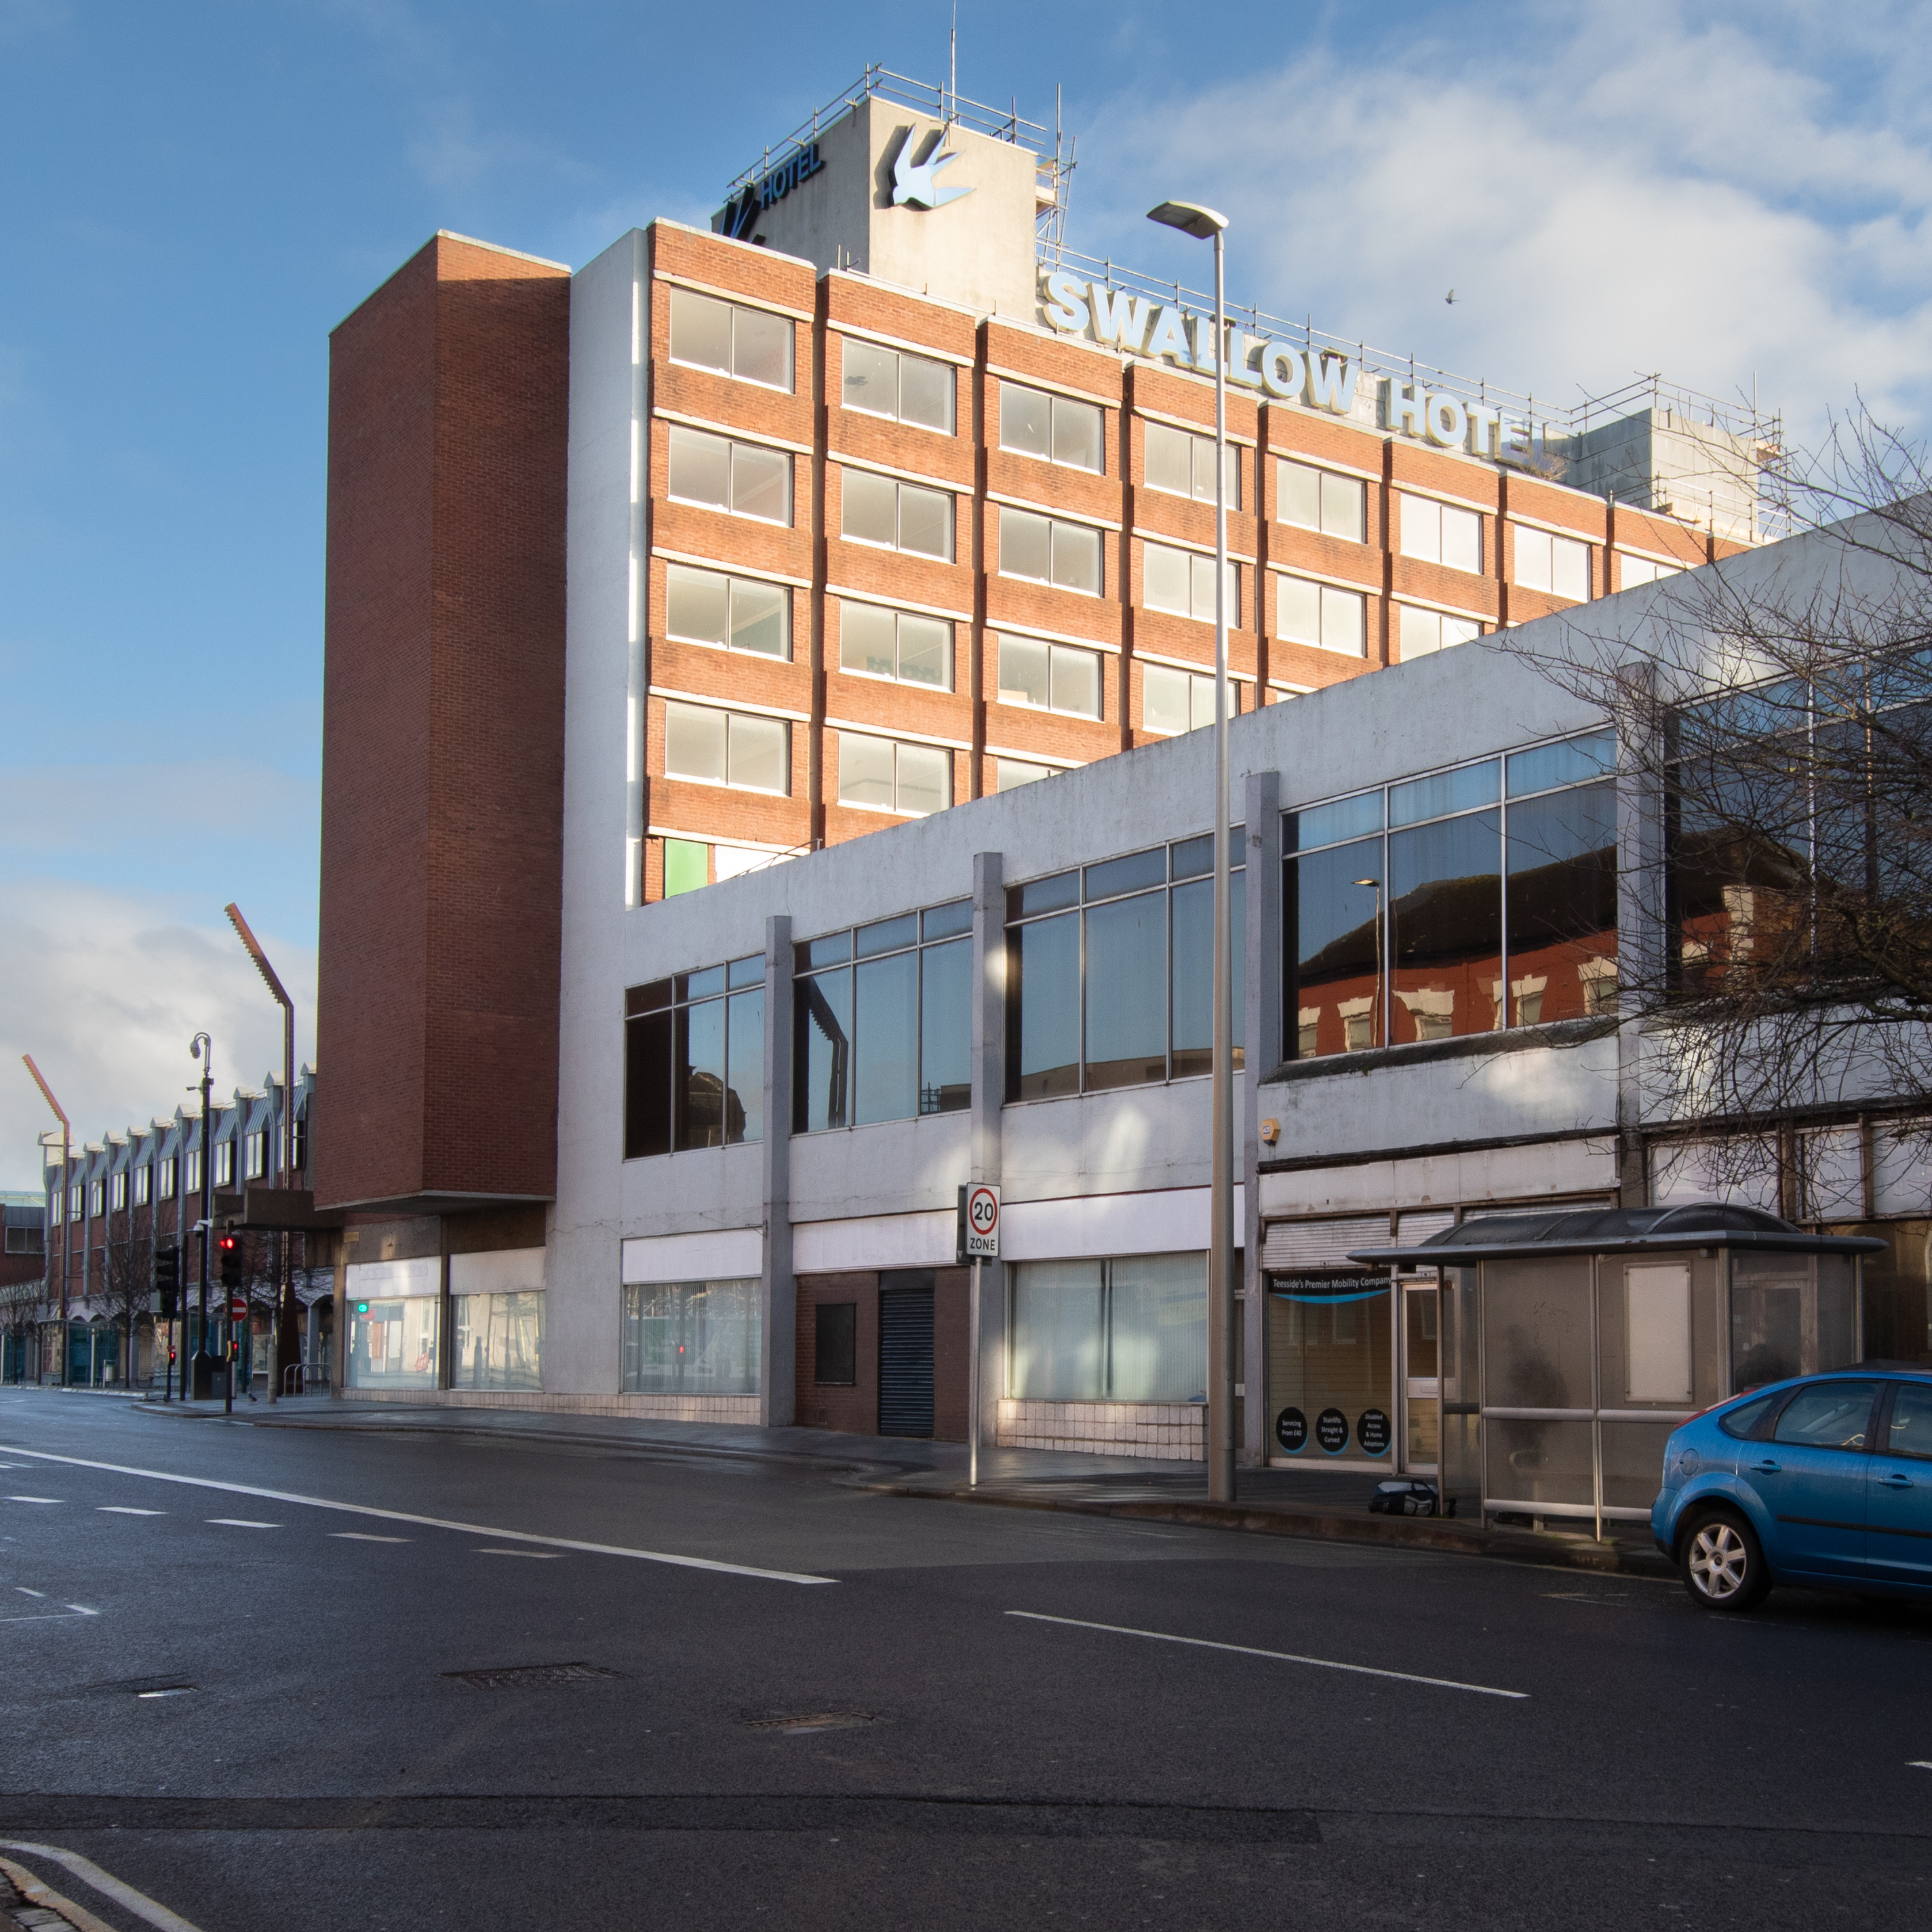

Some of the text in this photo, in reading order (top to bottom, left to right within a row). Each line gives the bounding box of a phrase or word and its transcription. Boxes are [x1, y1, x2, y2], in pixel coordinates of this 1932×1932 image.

[760, 143, 821, 209] HOTEL
[1043, 271, 1359, 415] SWALLOW
[974, 1202, 993, 1221] 20
[970, 1238, 995, 1250] ZONE
[1273, 1276, 1391, 1288] Teesside's Premier Mobility Company
[1321, 1426, 1338, 1434] Straight
